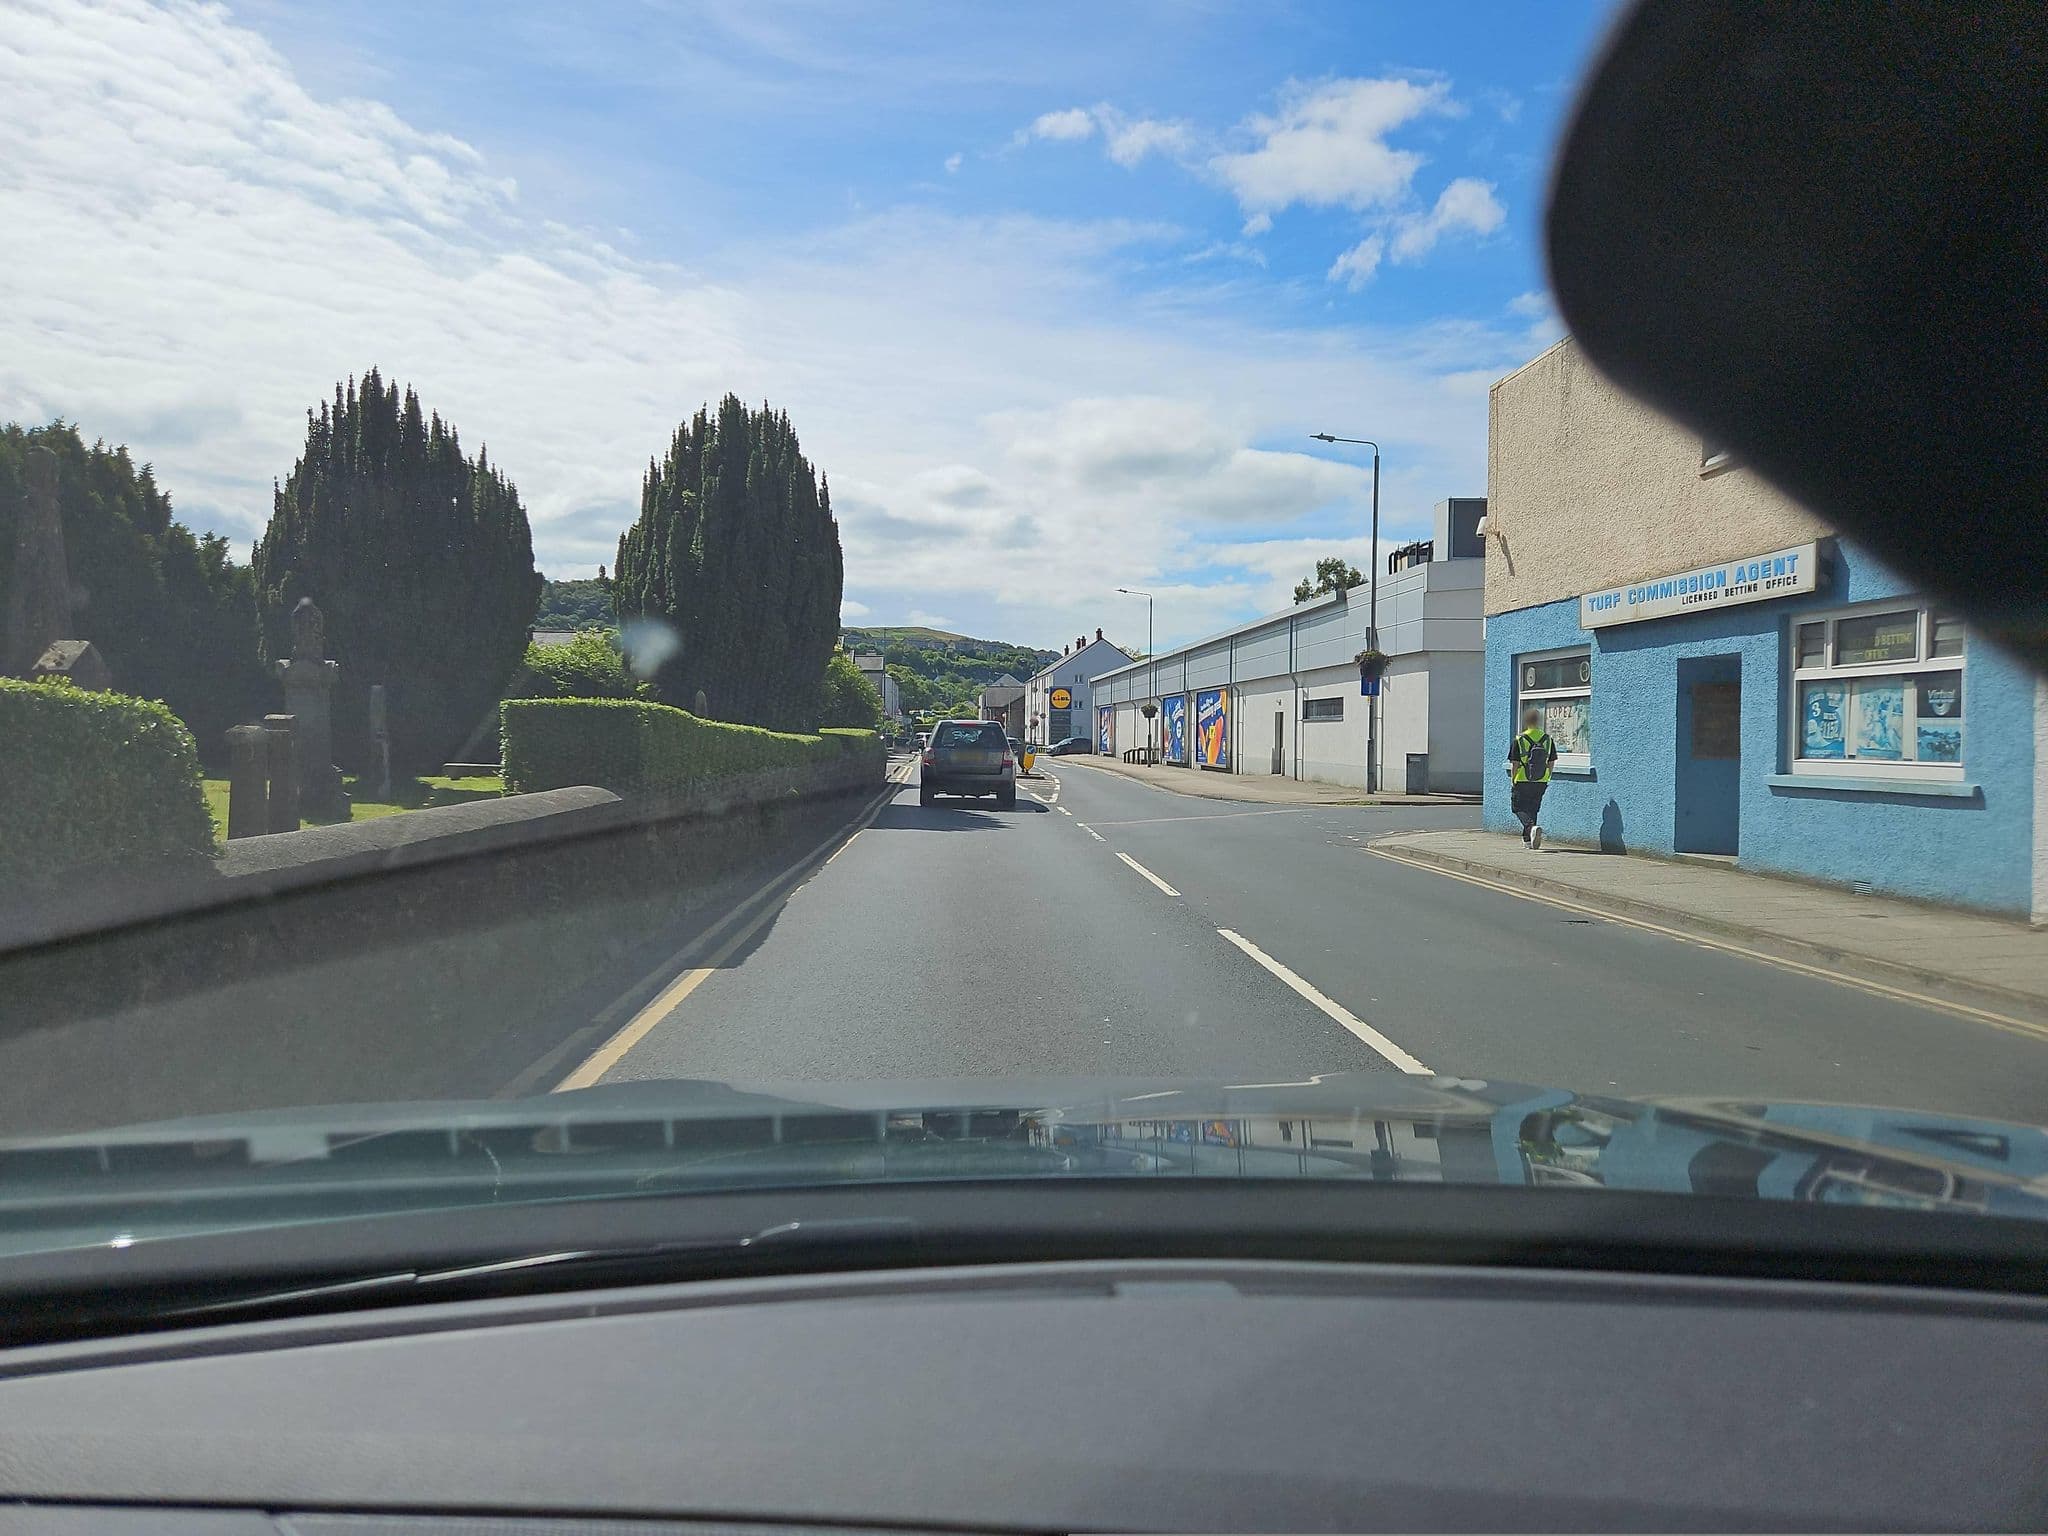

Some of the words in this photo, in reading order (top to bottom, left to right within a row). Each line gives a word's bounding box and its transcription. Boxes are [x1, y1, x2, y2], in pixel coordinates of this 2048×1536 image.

[1588, 592, 1621, 612] TURF
[1628, 569, 1727, 605] COMMISSION
[1734, 554, 1799, 584] AGENT
[1681, 590, 1718, 606] LICENSED
[1724, 582, 1758, 598] BETTING
[1766, 575, 1798, 590] OFFICE
